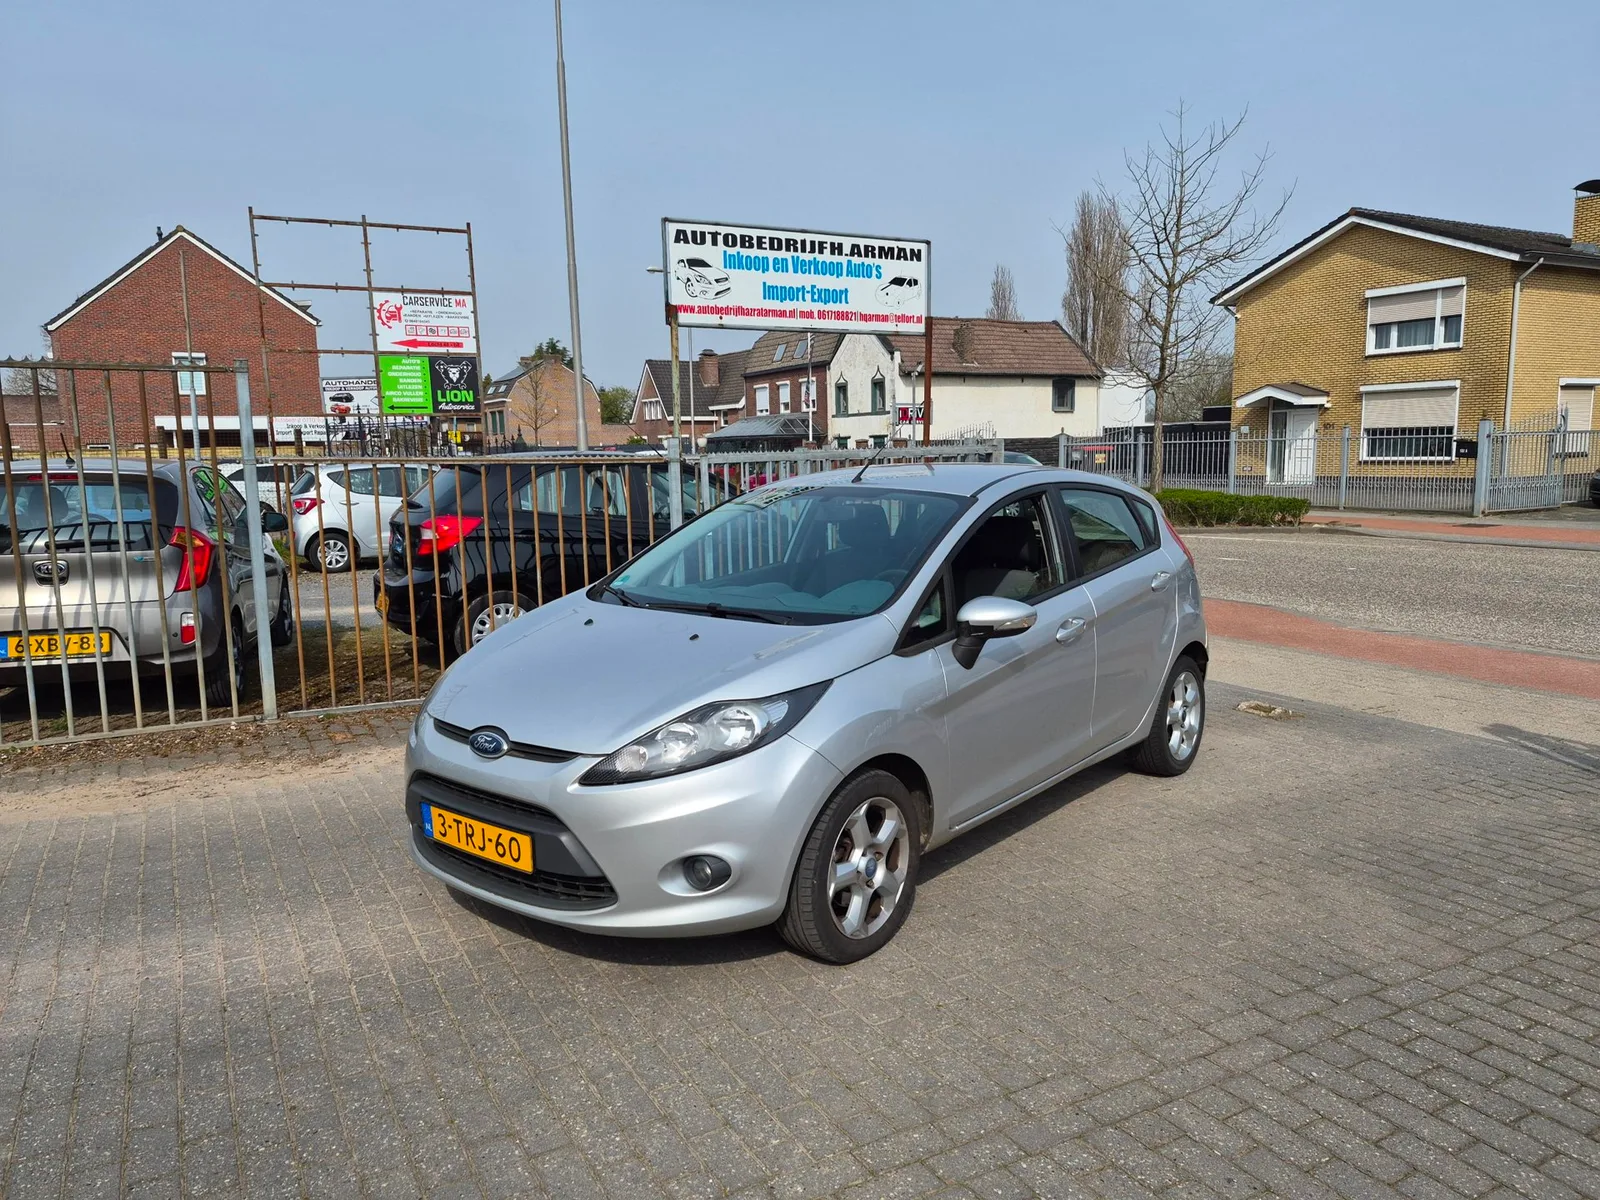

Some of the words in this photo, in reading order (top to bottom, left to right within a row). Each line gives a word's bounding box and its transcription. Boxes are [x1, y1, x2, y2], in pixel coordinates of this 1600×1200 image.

[723, 250, 770, 274] Inkoop
[772, 258, 789, 273] en
[791, 255, 844, 279] Verkoop
[846, 260, 882, 279] Auto's
[402, 295, 452, 308] CARSERVICE
[455, 299, 467, 308] MA
[762, 281, 849, 305] Import-Export
[437, 389, 474, 403] LION
[474, 734, 497, 752] Ford
[437, 813, 521, 863] 3-TRJ-60
